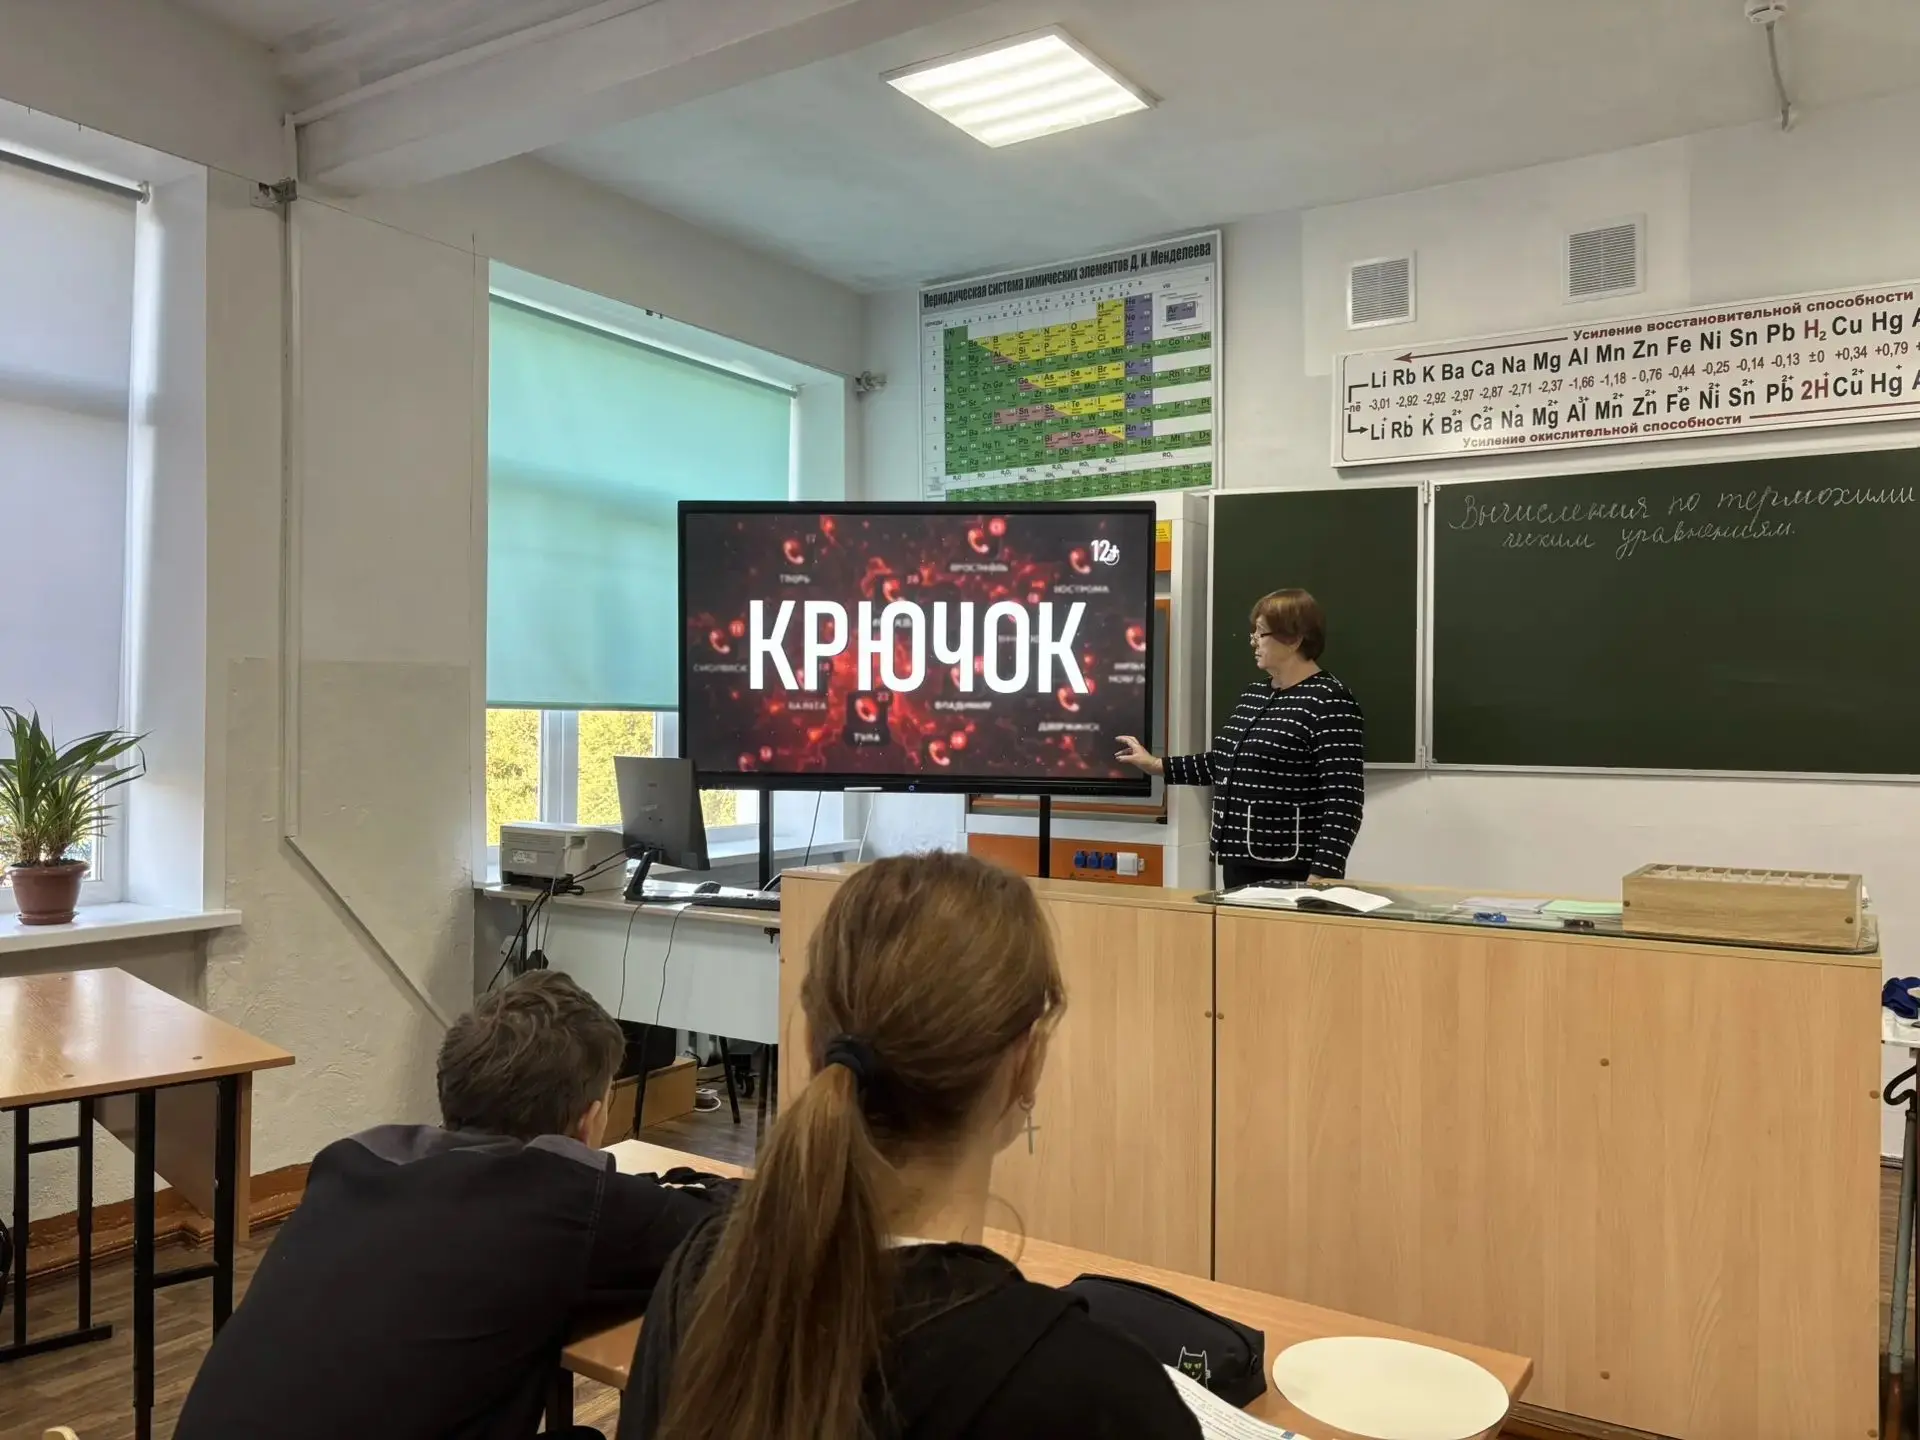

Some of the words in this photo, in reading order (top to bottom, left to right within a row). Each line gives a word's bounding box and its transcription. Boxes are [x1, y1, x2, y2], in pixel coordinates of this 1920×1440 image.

[923, 286, 987, 309] Периодическая
[988, 277, 1024, 295] система
[1024, 266, 1078, 290] химических
[1079, 260, 1128, 280] элементов
[1130, 253, 1139, 272] Д.
[1140, 251, 1149, 268] И.
[1150, 242, 1211, 264] Менделеева
[1573, 324, 1642, 341] Усиление
[1647, 302, 1801, 333] восстановительной
[1806, 291, 1914, 313] способности
[1371, 370, 1387, 389] Li
[1392, 367, 1416, 386] Rb
[1423, 365, 1435, 383] K
[1442, 363, 1465, 380] Ba
[1471, 360, 1495, 378] Ca
[1502, 356, 1526, 374] Na
[1533, 352, 1561, 373] Mg
[1568, 347, 1588, 367] Al
[1596, 344, 1625, 363] Mn
[1632, 340, 1658, 360] Zn
[1667, 336, 1692, 355] Fe
[1700, 330, 1721, 350] Ni
[1730, 328, 1758, 348] Sn
[1767, 322, 1795, 344] Pb
[1832, 316, 1862, 336] Cu
[1872, 311, 1903, 334] Hg
[1368, 398, 1390, 411] -3,01
[1396, 394, 1418, 408] -2,92
[1423, 392, 1446, 405] -2,92
[1451, 388, 1474, 402] -2,97
[1480, 386, 1504, 400] -2,87
[1508, 382, 1532, 398] -2,71
[1538, 379, 1563, 394] -2,37
[1568, 376, 1594, 390] -1,66
[1600, 372, 1626, 387] -1,18
[1668, 364, 1696, 380] -0,44
[1702, 360, 1730, 376] -0,25
[1736, 356, 1764, 372] -0,14
[1771, 352, 1800, 368] -0,13
[1835, 345, 1868, 362] +0,34
[1875, 341, 1908, 358] +0,79
[1462, 434, 1526, 448] Усиление
[1530, 422, 1638, 443] окислительной
[1642, 414, 1742, 433] способности
[1449, 495, 1650, 529] Вычисления
[1668, 492, 1700, 515] по
[1090, 539, 1120, 562] 12+
[1503, 532, 1596, 548] ческим
[750, 600, 1089, 694] КРЮЧОК
